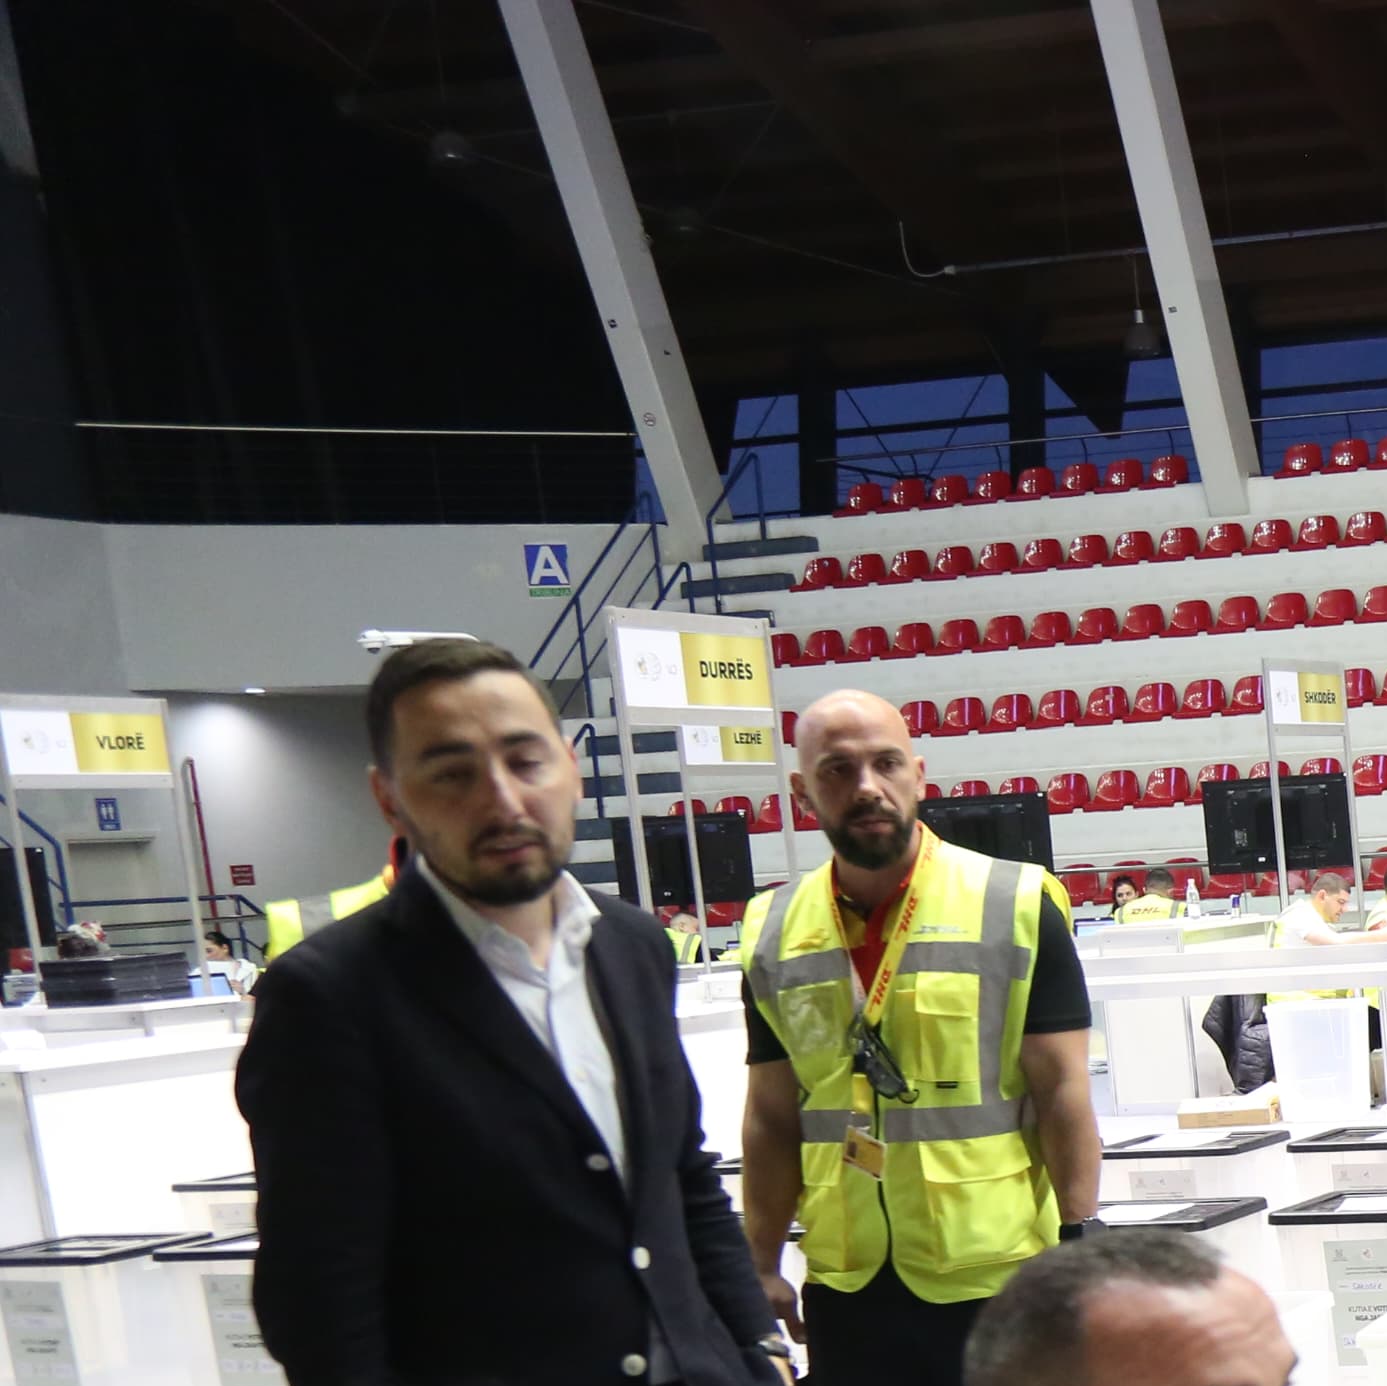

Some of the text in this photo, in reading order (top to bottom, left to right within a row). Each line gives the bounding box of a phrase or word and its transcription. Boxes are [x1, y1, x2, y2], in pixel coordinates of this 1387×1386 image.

[530, 545, 569, 585] A
[699, 658, 753, 680] DURRËS
[1304, 689, 1336, 704] SHKODËR
[96, 733, 145, 750] VLORË
[734, 731, 762, 744] LEZHË
[899, 896, 919, 933] DHL
[1131, 907, 1160, 915] DHL
[872, 969, 892, 1005] DHL
